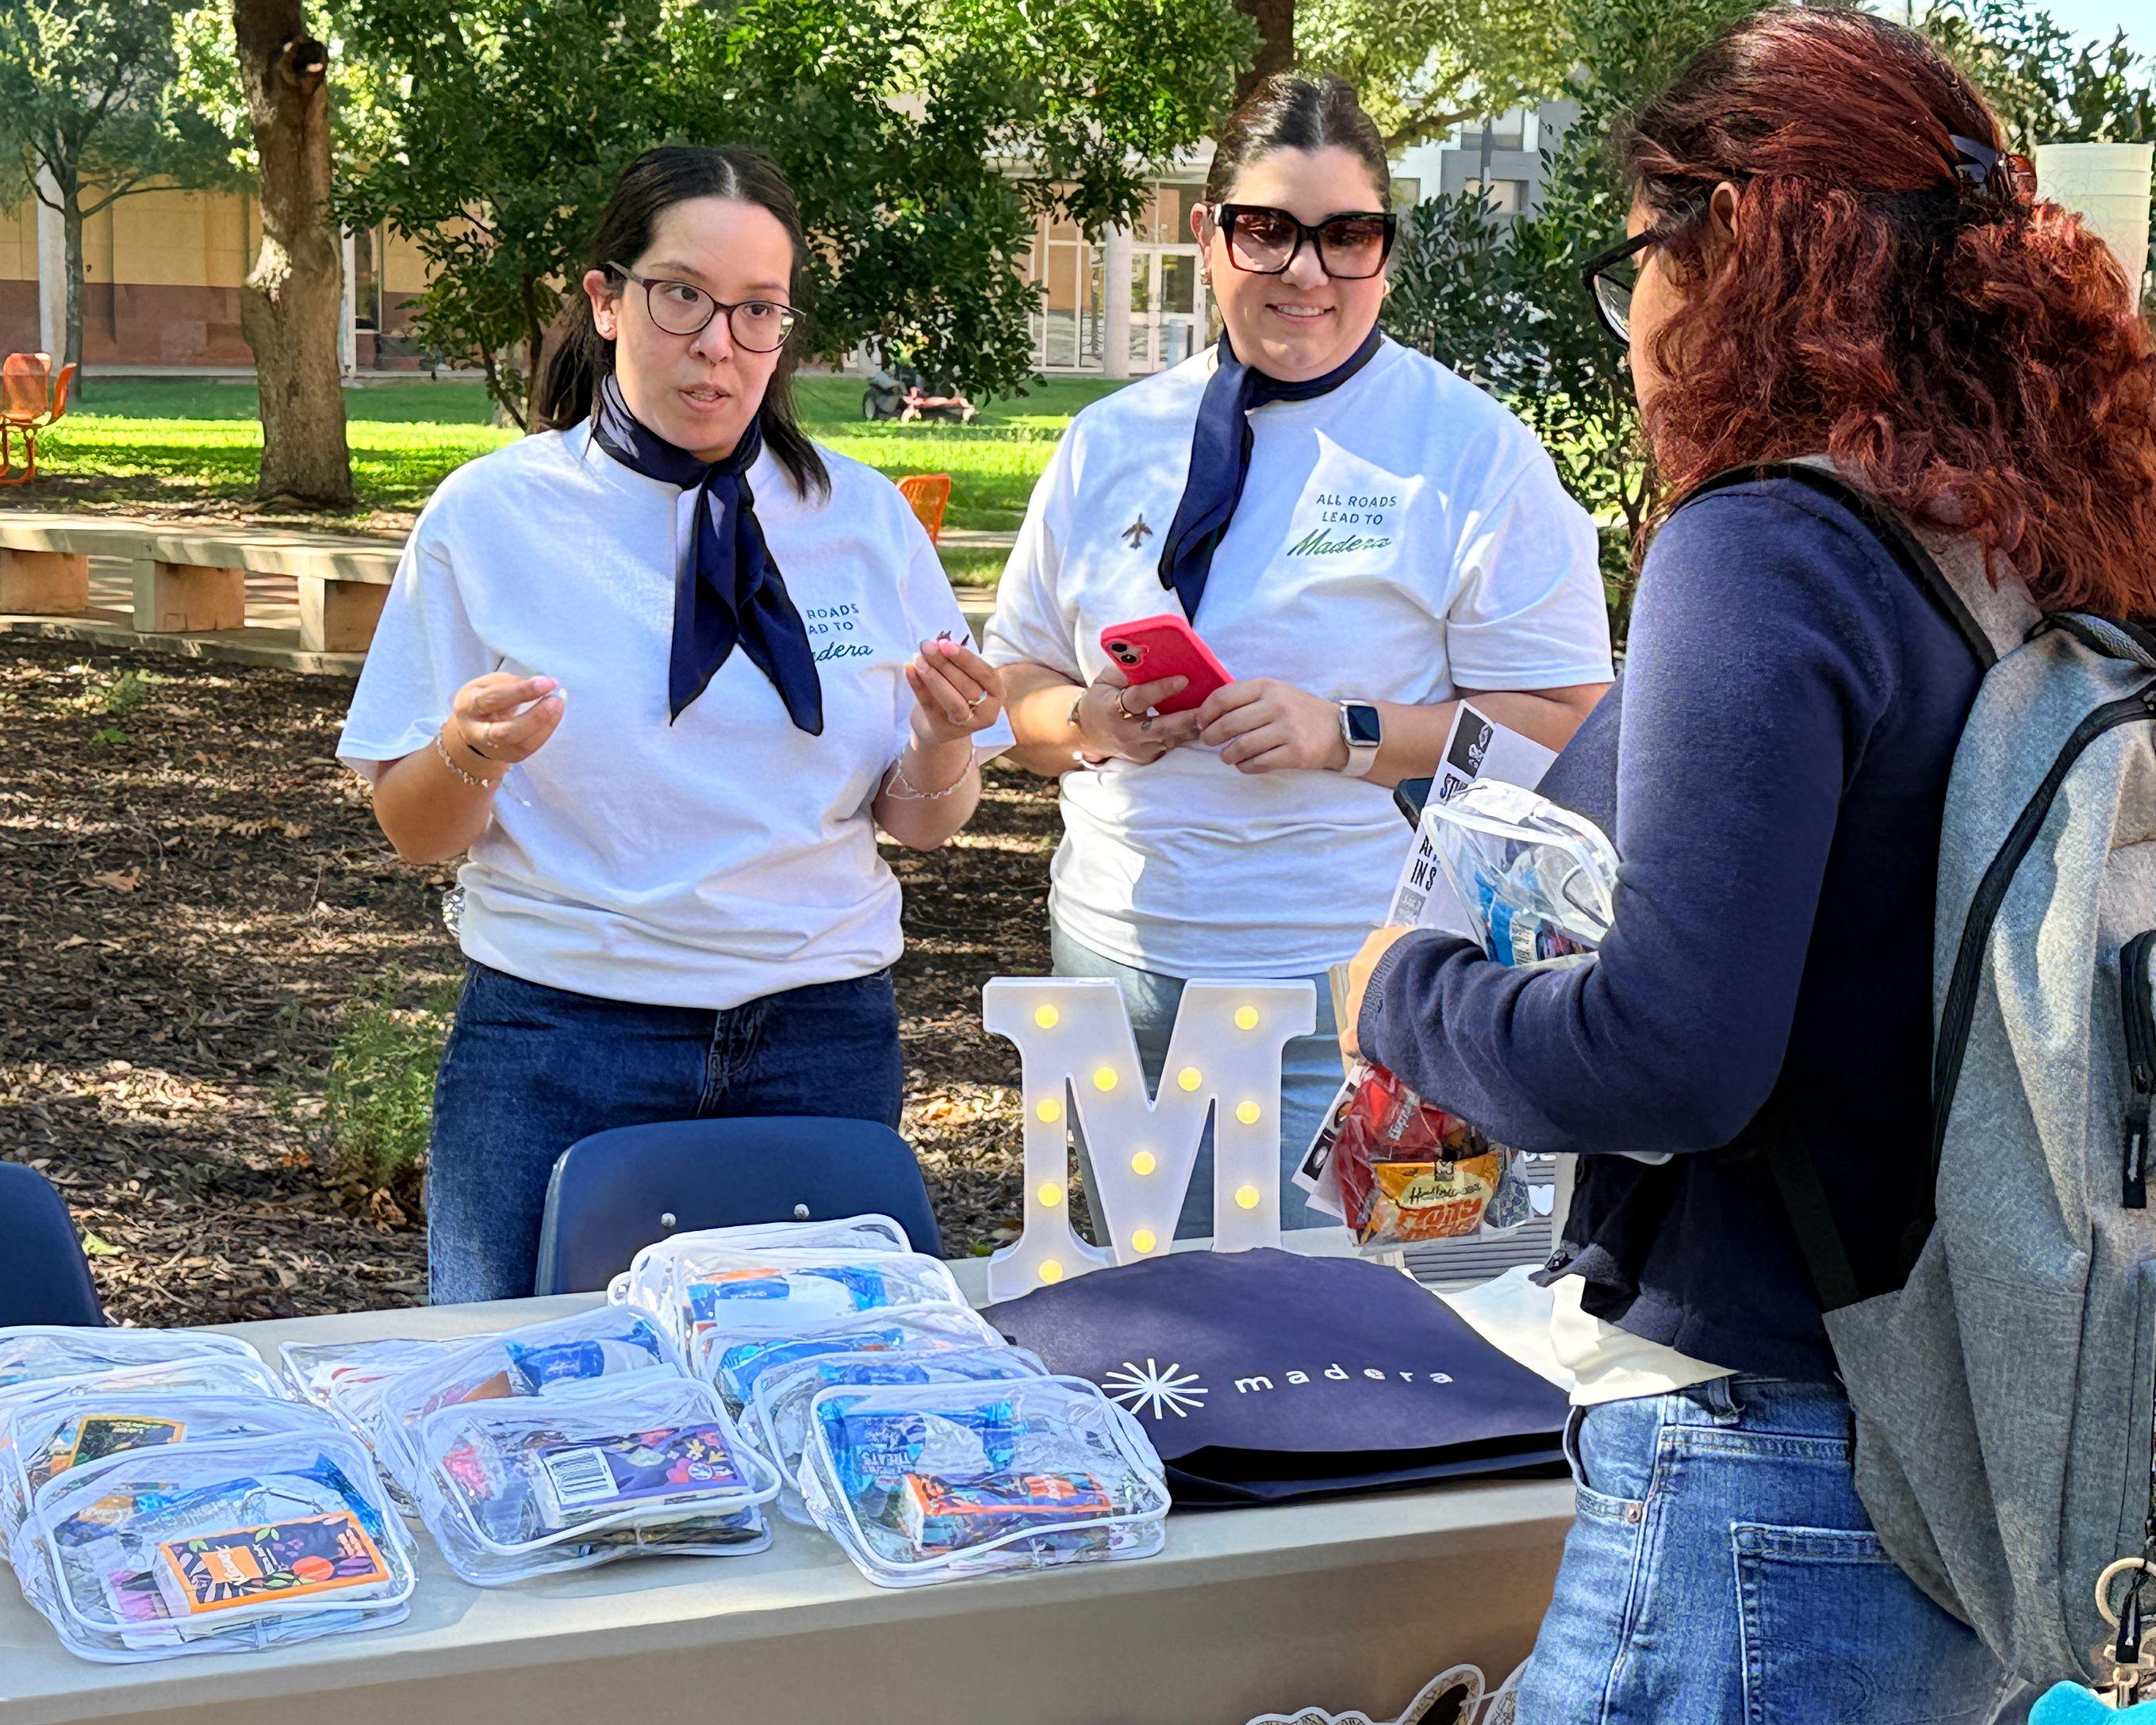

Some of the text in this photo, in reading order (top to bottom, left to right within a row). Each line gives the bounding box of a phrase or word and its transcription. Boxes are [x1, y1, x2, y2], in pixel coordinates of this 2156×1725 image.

[1316, 494, 1398, 508] ALL ROADS
[1322, 512, 1383, 525] LEAD TO
[1287, 527, 1392, 556] Madera
[806, 604, 859, 619] ROADS
[809, 621, 854, 634] AD TO
[812, 641, 873, 662] dera
[1234, 1363, 1455, 1394] madera
